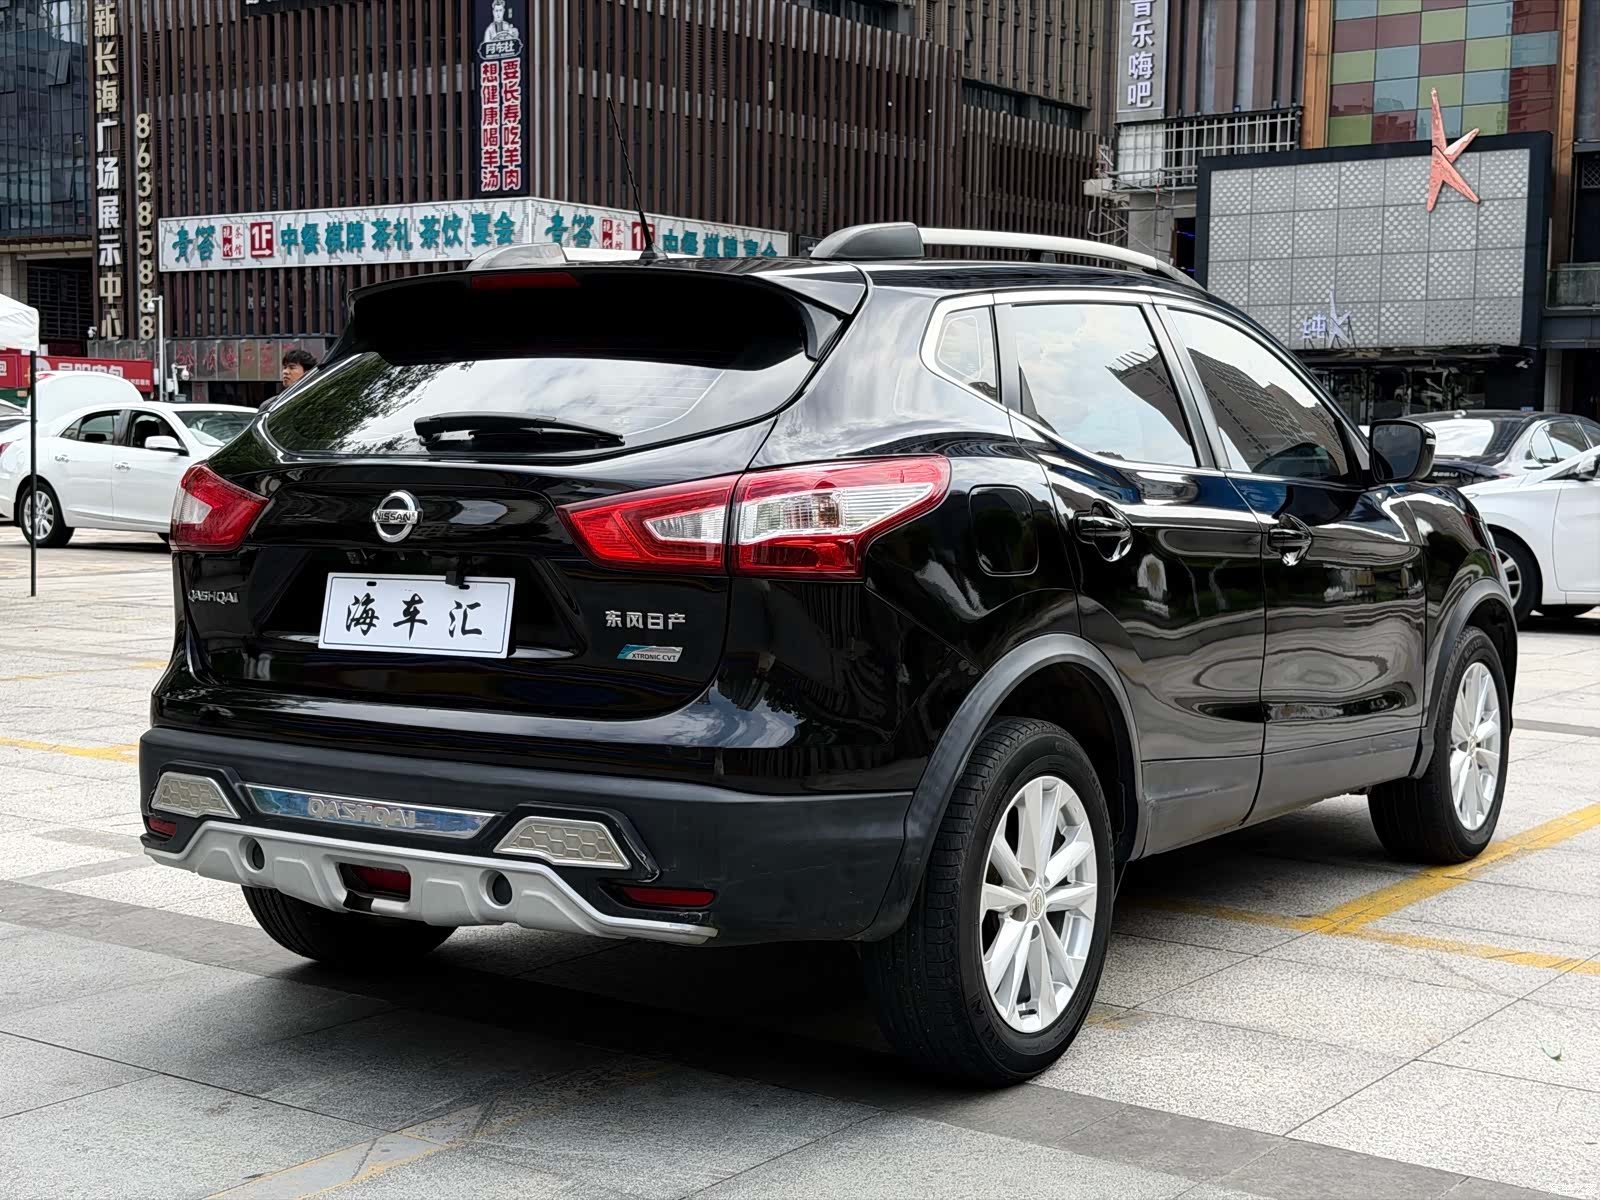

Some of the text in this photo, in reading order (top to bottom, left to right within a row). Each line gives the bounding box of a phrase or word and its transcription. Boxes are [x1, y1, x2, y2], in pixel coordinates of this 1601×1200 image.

[481, 61, 500, 191] 想健康喝羊汤
[501, 58, 520, 190] 要长寿吃羊肉
[94, 1, 122, 341] 新长海广场展示中心
[136, 113, 154, 340] 86385888
[252, 224, 272, 249] 1F
[375, 511, 411, 521] NISSAN
[188, 590, 239, 604] QASHQAI
[345, 592, 483, 641] 海车汇
[605, 610, 686, 630] 东风日产
[307, 797, 416, 829] QASHQAI
